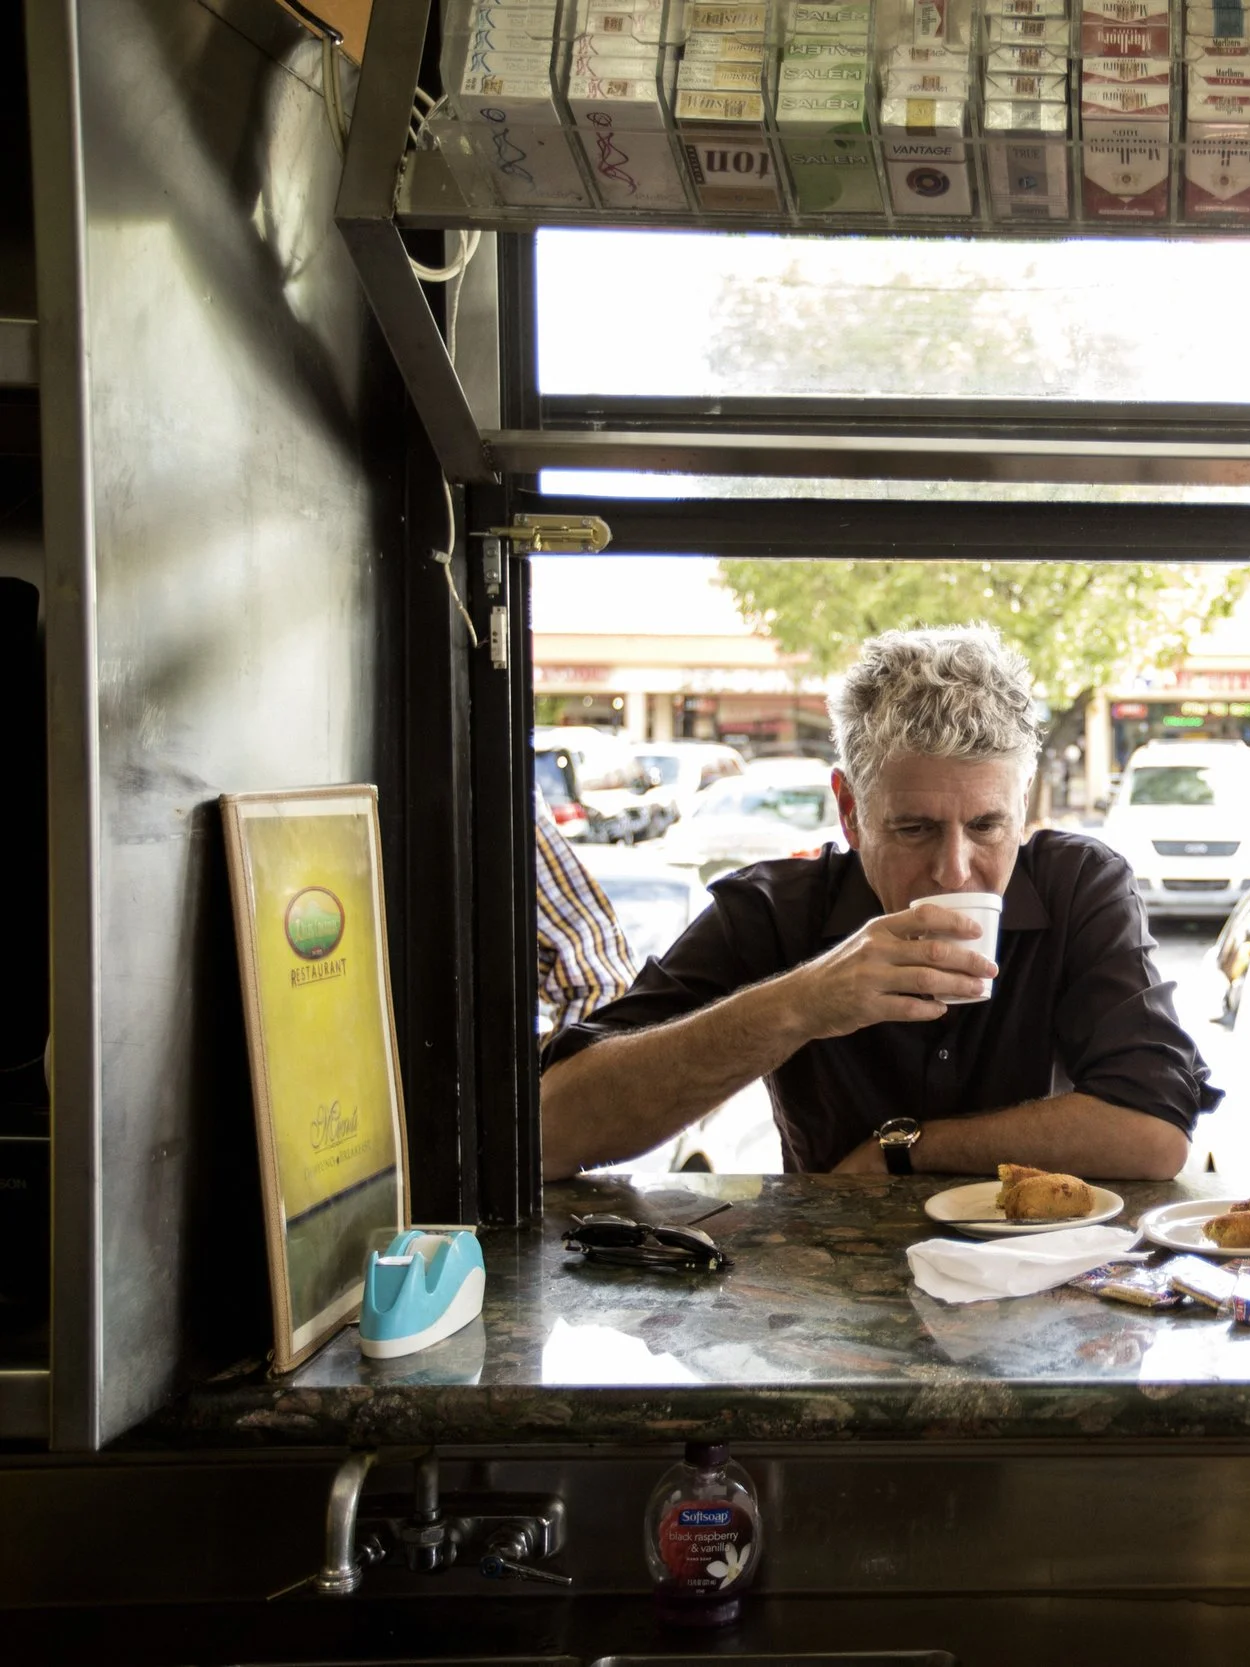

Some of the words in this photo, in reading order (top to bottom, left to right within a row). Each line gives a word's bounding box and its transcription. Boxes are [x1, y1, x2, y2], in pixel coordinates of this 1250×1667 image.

[794, 9, 868, 22] SALEM
[1098, 32, 1151, 54] Marlboro
[790, 43, 867, 57] SALEM
[783, 67, 862, 81] SALEM
[781, 98, 860, 110] SALEM
[893, 145, 952, 156] VANTAGE
[1014, 149, 1041, 159] TRUE
[791, 154, 867, 166] SALEM
[291, 958, 347, 988] RESTAURANT
[682, 1510, 729, 1524] Softsoap
[669, 1531, 692, 1541] black
[694, 1531, 739, 1544] raspberry
[690, 1543, 698, 1553] &
[700, 1542, 730, 1553] vanilla
